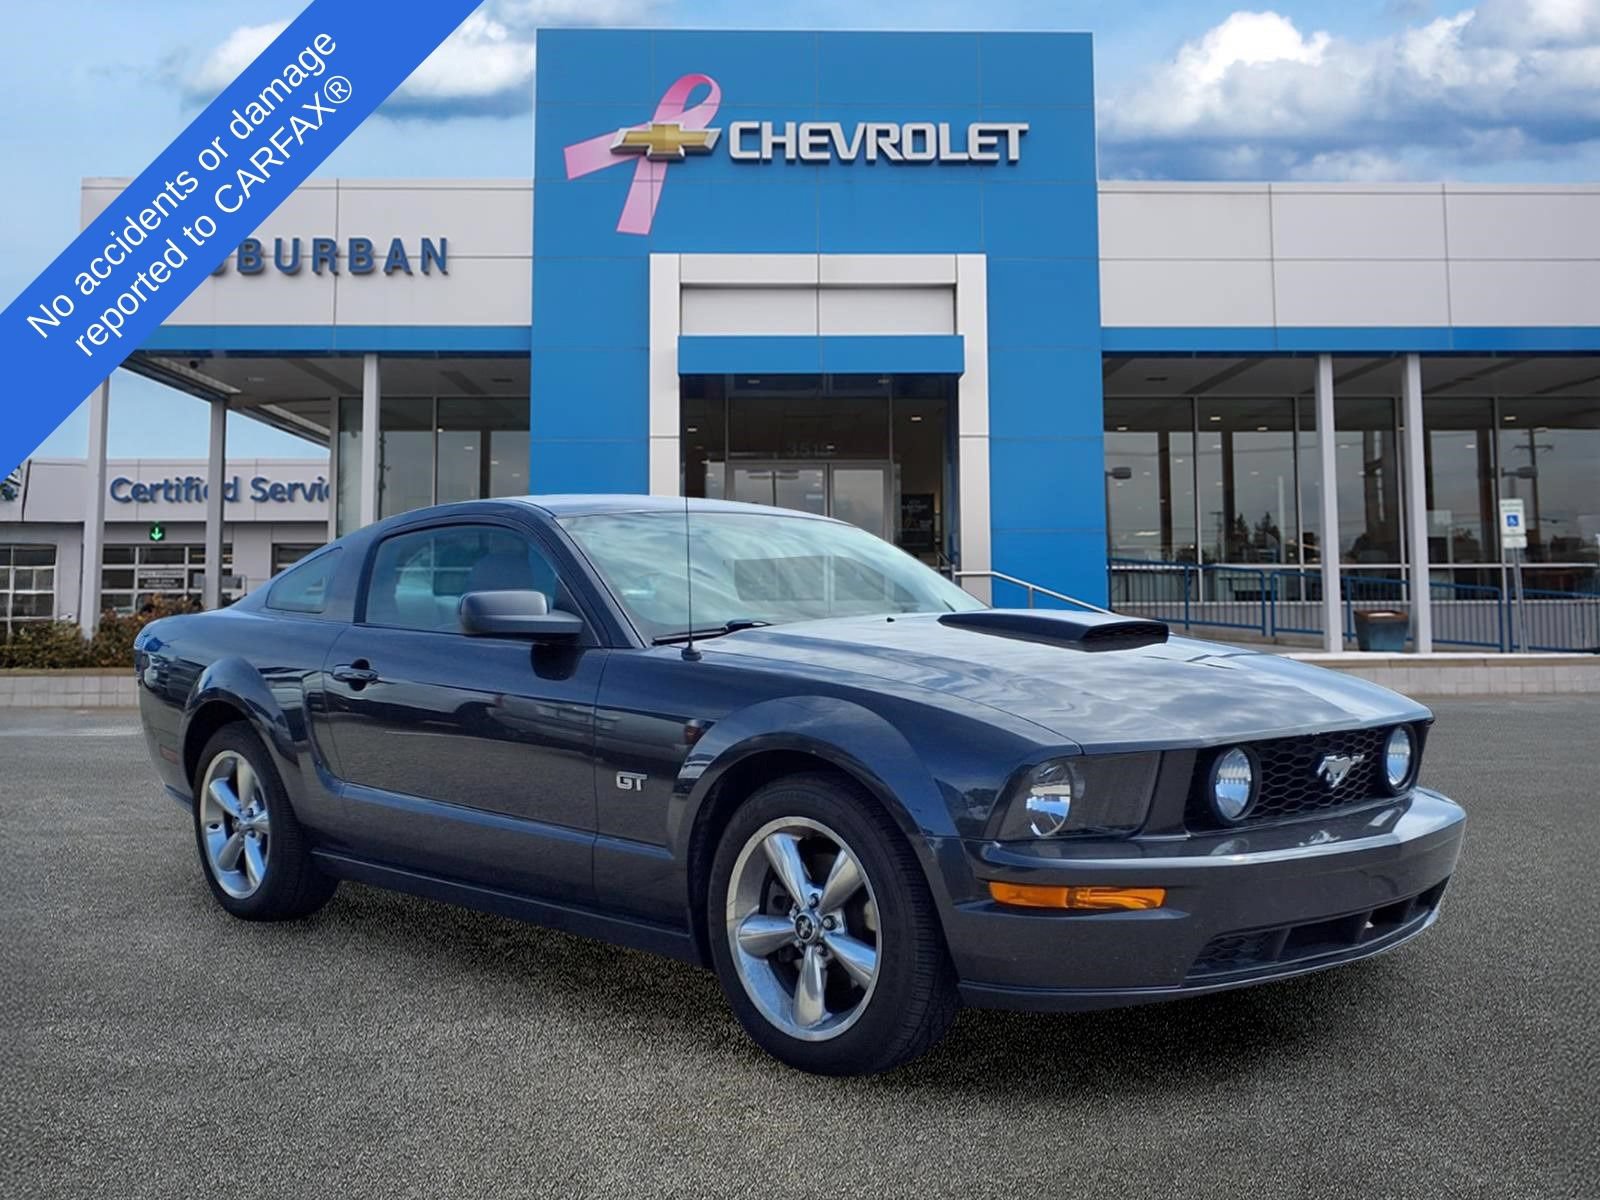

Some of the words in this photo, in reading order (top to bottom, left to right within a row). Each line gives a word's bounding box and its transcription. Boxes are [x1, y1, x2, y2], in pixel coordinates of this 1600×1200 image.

[729, 121, 1029, 162] CHEVROLET
[211, 237, 448, 275] BURBAN
[616, 771, 648, 792] GT
